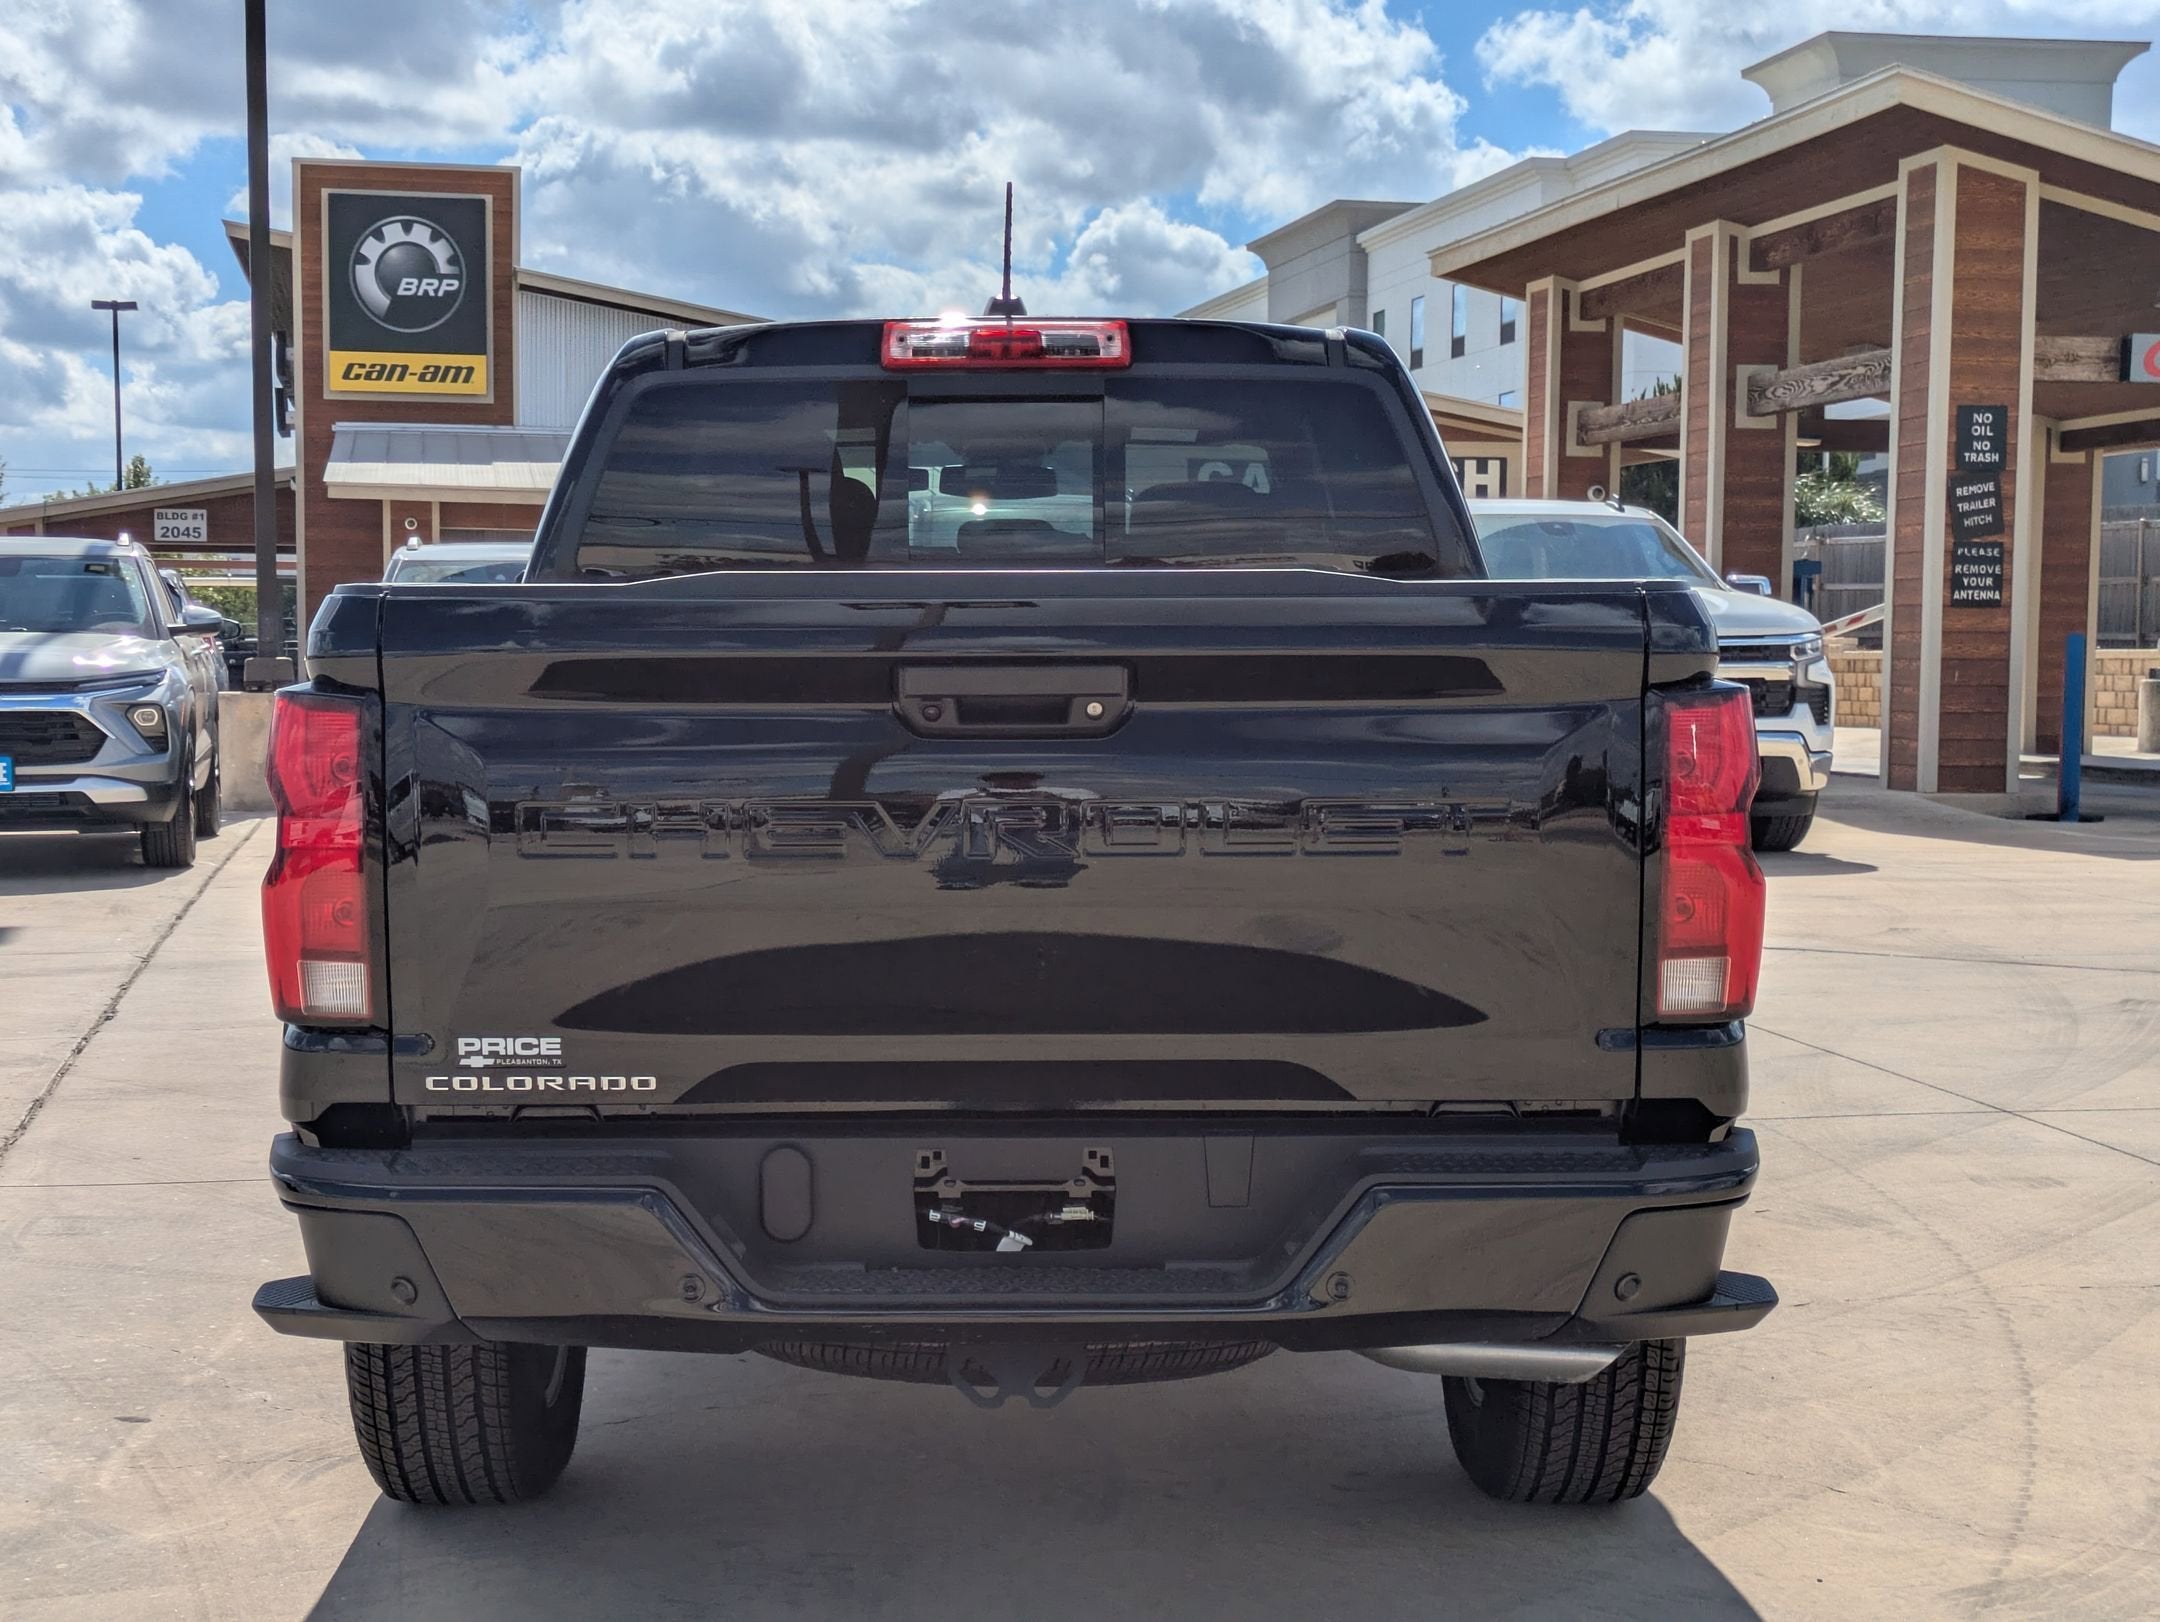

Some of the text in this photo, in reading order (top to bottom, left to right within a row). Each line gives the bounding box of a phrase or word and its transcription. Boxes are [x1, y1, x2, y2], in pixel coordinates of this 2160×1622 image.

[396, 277, 460, 297] BRP
[341, 362, 476, 384] can-am
[1973, 412, 1993, 424] NO
[1971, 425, 1994, 436] OIL
[1972, 440, 1991, 451] NO
[1963, 452, 2000, 463] TRASH
[1955, 481, 1996, 497] REMOVE
[1957, 497, 1996, 512] TRAILER
[156, 511, 204, 521] BLDG #1
[1963, 514, 1993, 527] HITCH
[160, 526, 202, 539] 2045
[1957, 547, 2000, 557] PLEASE
[1954, 564, 2001, 574] REMOVE
[1962, 577, 1993, 587] YOUR
[1953, 589, 2001, 600] ANTENNA
[514, 799, 1510, 859] CHEVROLET
[457, 1037, 562, 1056] PRICE
[425, 1076, 657, 1091] COLORADO
